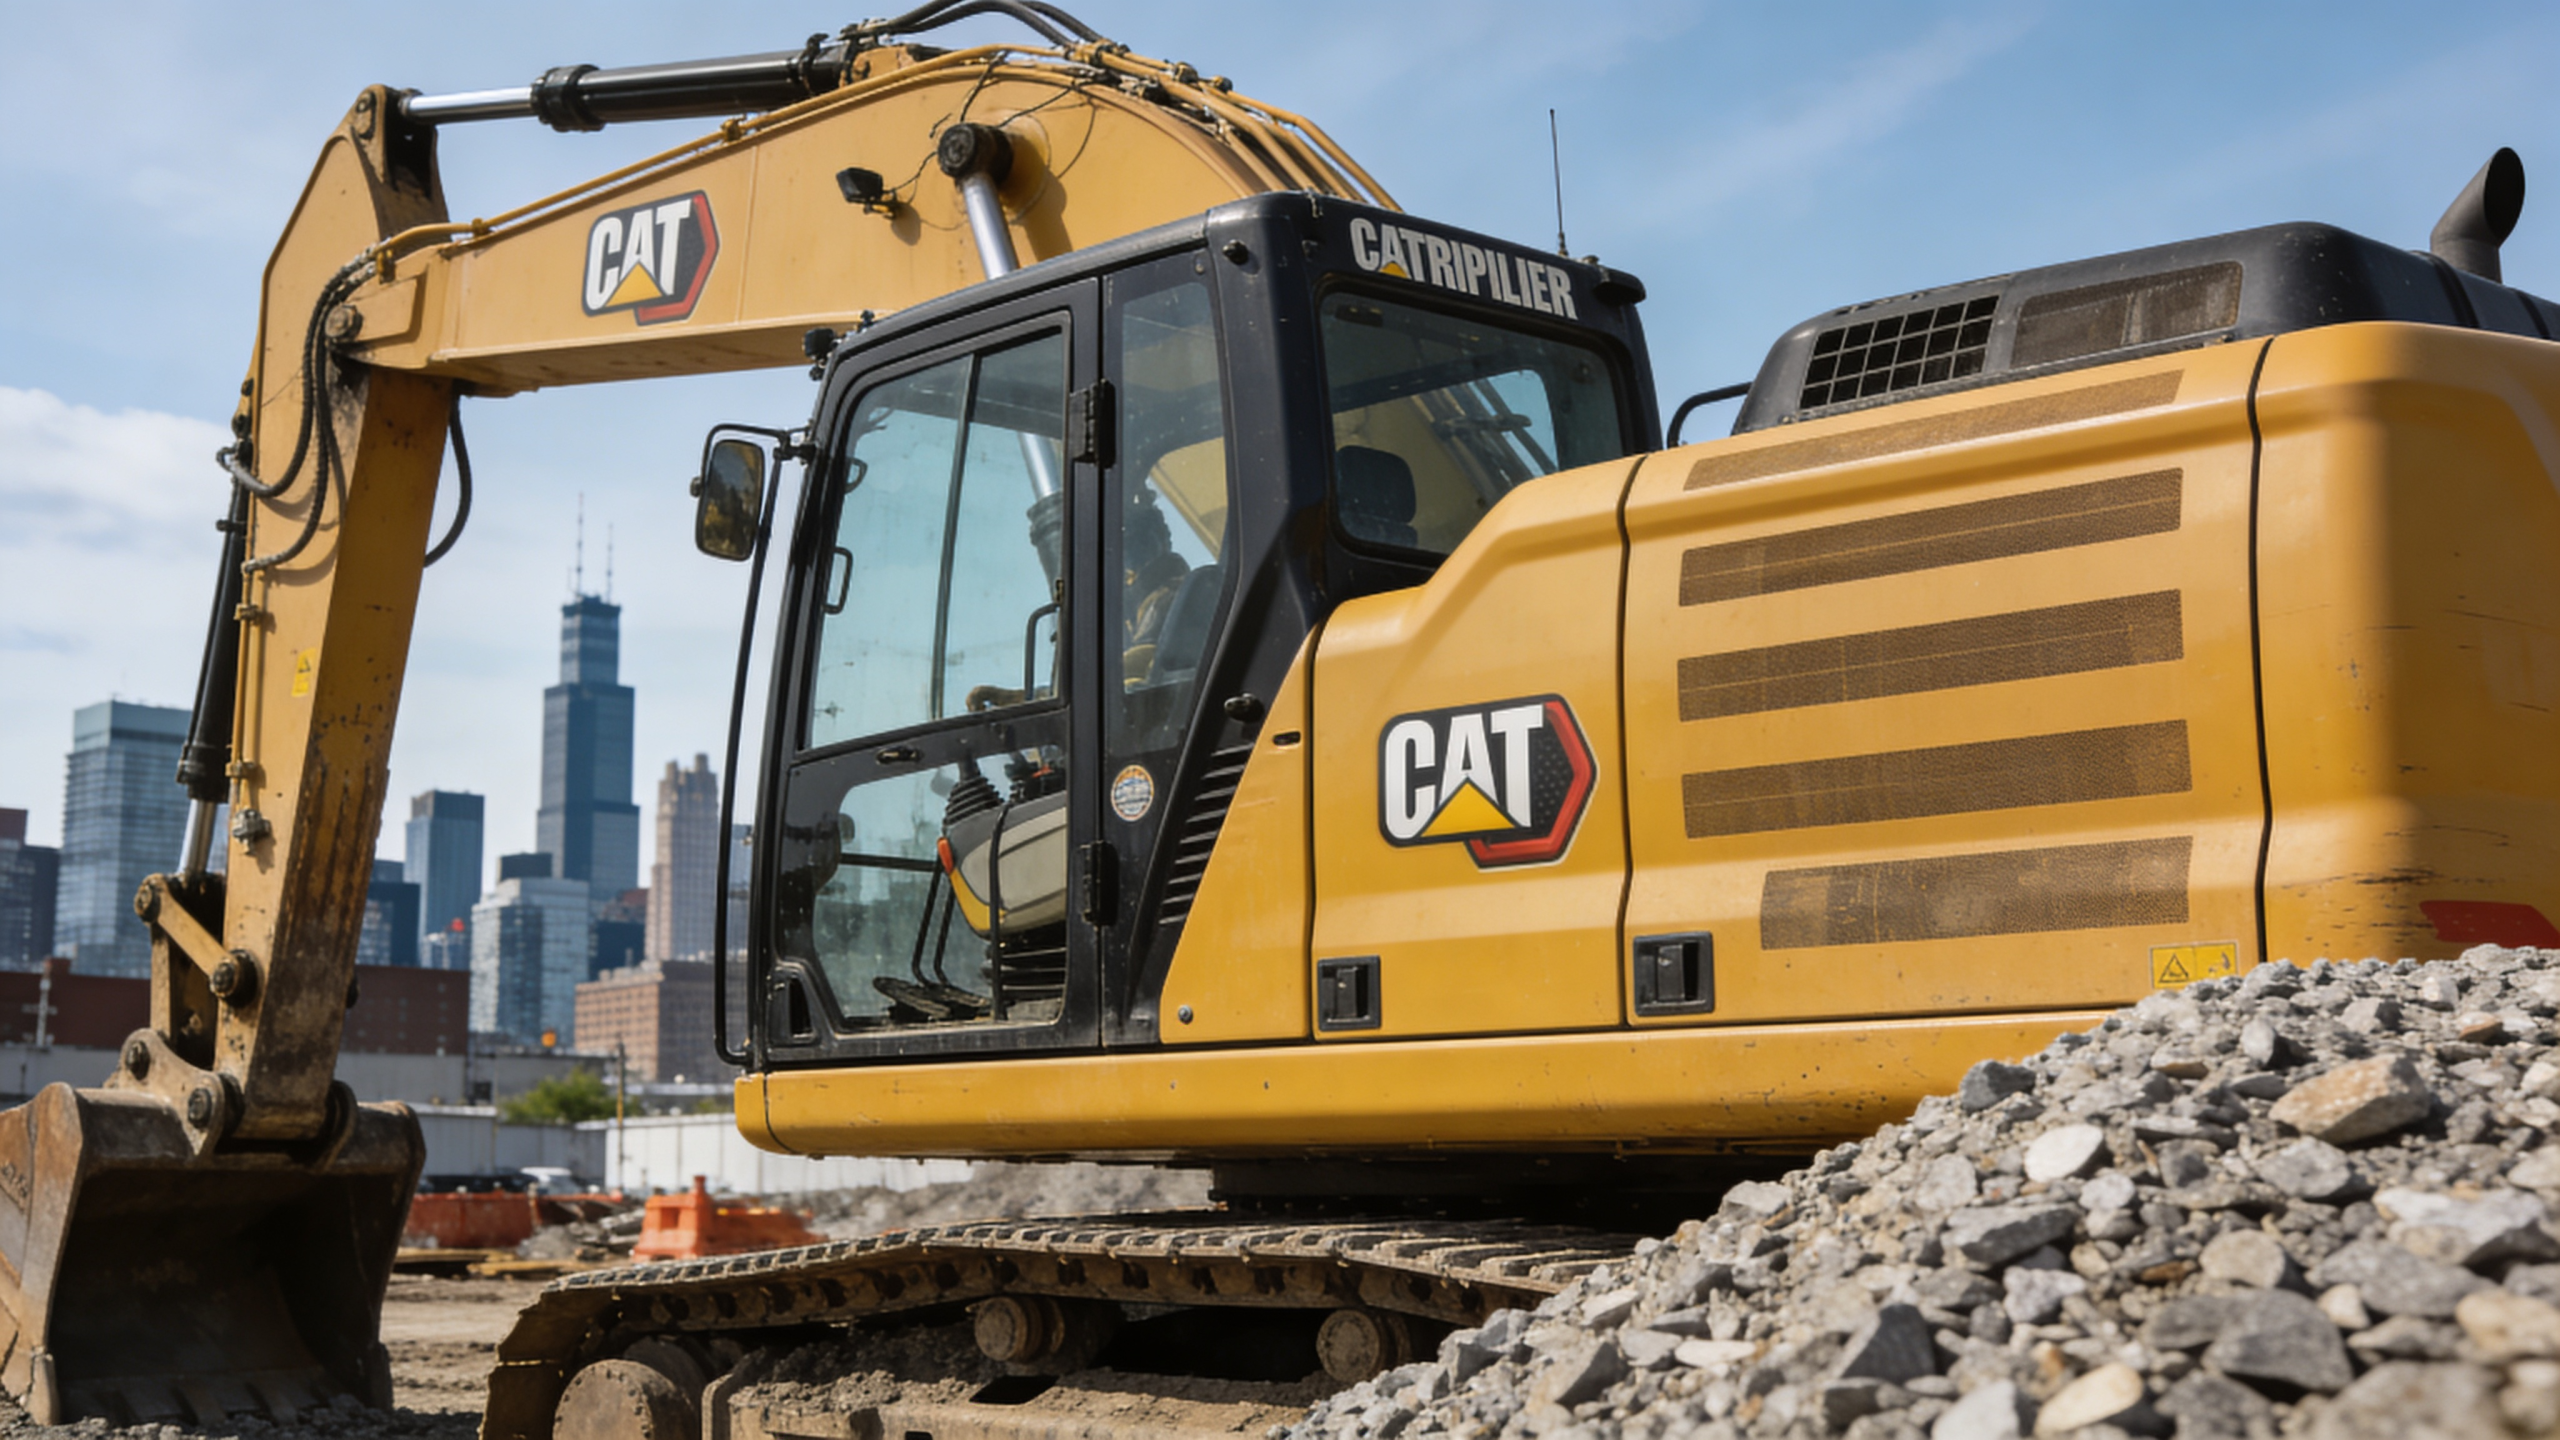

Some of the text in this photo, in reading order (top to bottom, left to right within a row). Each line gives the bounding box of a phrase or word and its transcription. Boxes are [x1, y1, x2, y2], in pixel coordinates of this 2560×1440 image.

[586, 198, 691, 310] CAT
[1349, 217, 1579, 320] CATRIPILIER
[1385, 704, 1544, 840] CAT
